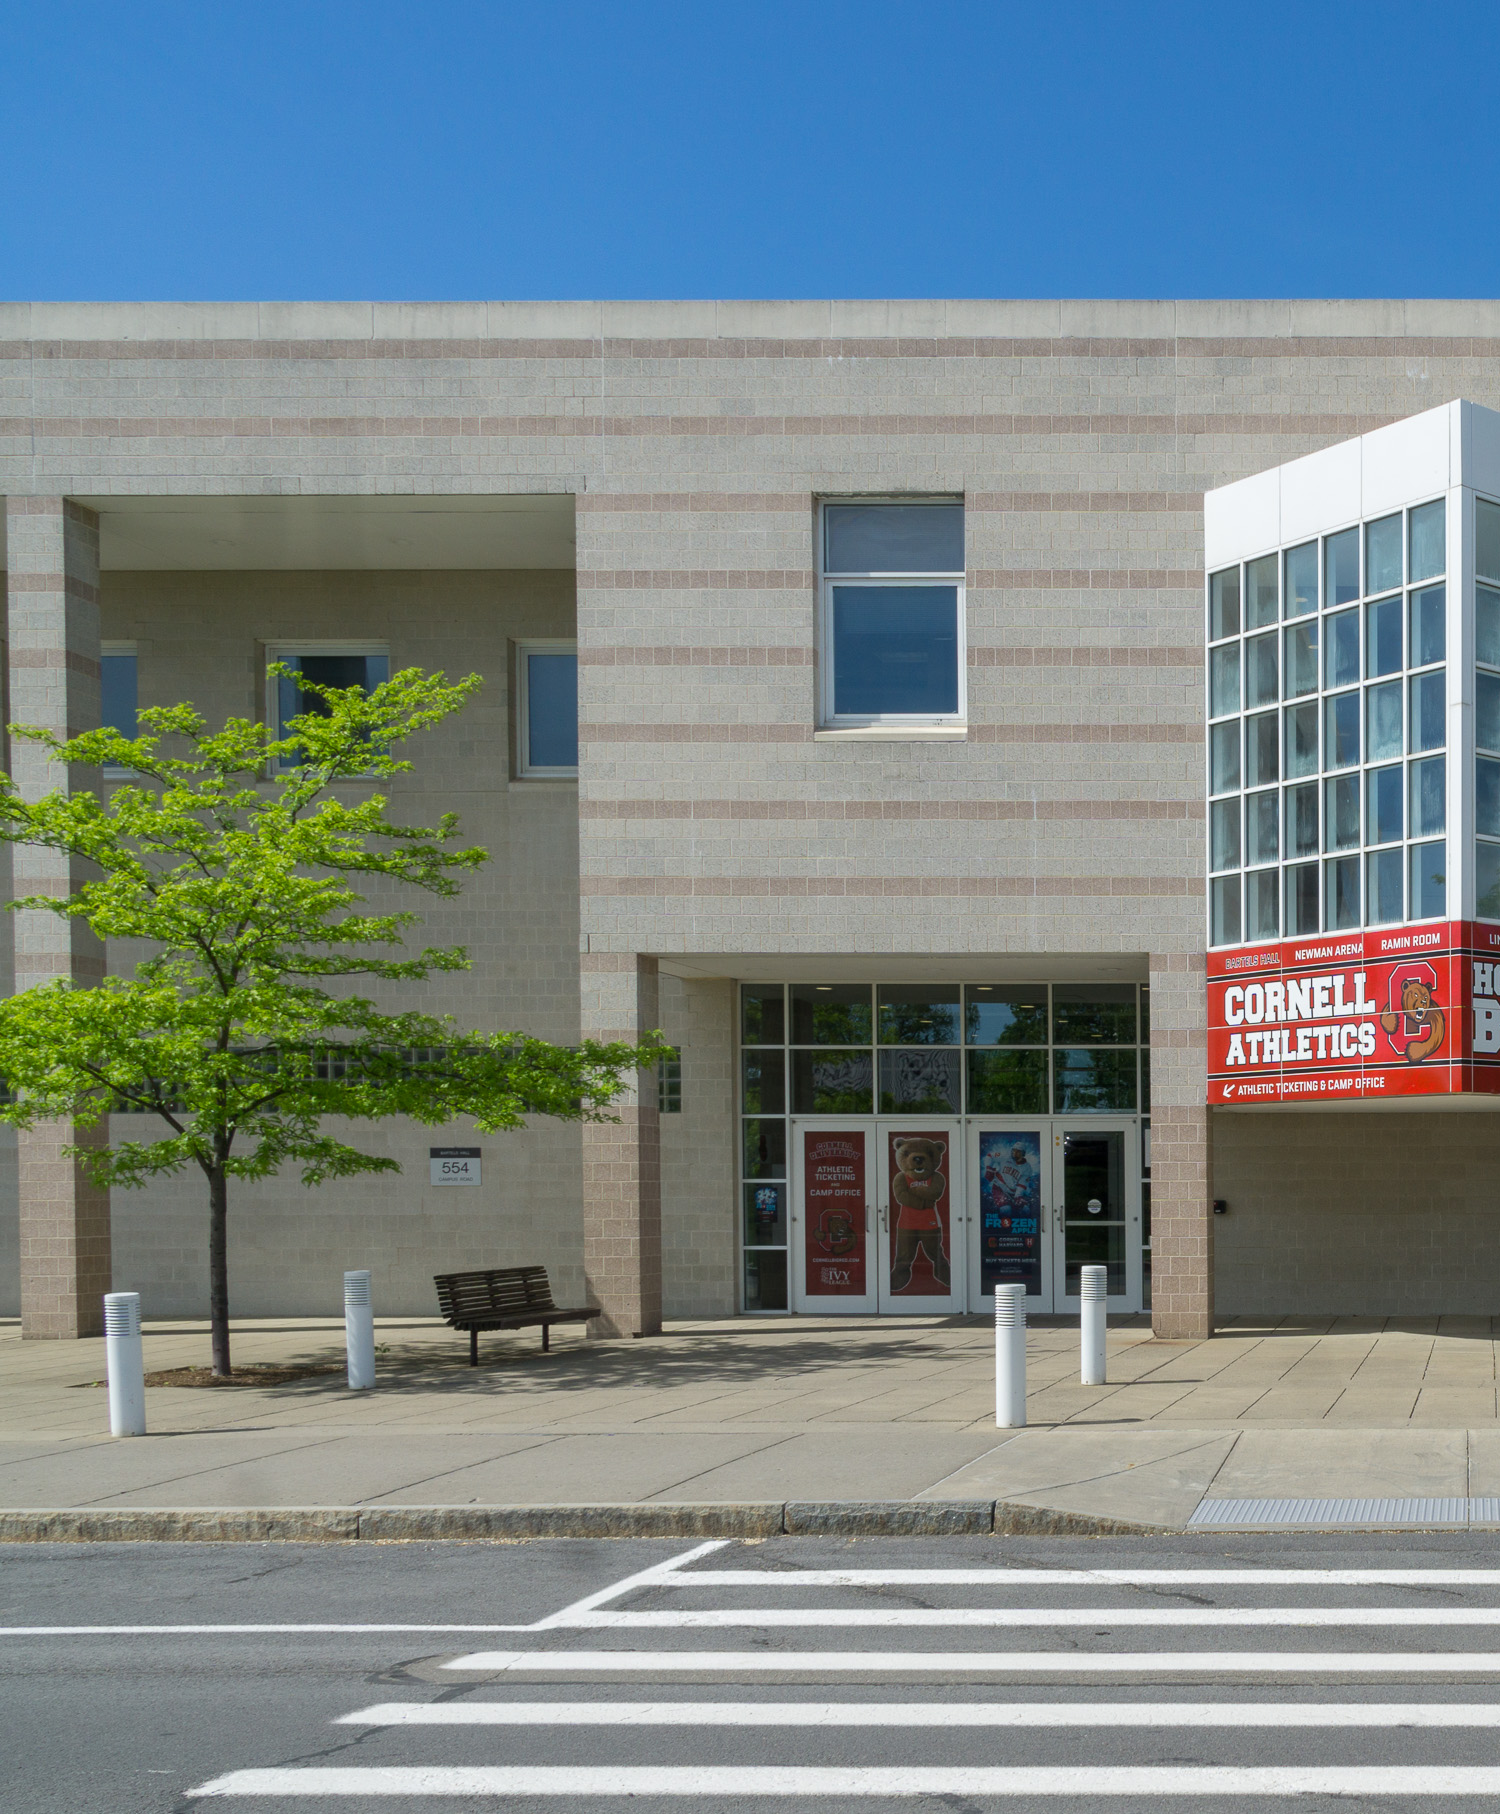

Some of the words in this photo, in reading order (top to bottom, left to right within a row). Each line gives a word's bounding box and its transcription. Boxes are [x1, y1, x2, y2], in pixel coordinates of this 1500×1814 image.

[1381, 936, 1411, 951] RAMIN
[1412, 933, 1441, 947] ROOM
[1225, 955, 1259, 970] BARTELS
[1260, 952, 1280, 966] HALL
[1295, 946, 1333, 961] NEWMAN
[1335, 943, 1364, 955] ARENA
[1224, 972, 1376, 1026] CORNELL
[1225, 1022, 1376, 1066] ATHLETICS
[1238, 1082, 1275, 1096] ATHLETIC
[1275, 1080, 1319, 1095] TICKETING
[1320, 1080, 1326, 1091] &
[1328, 1078, 1353, 1091] CAMP
[1355, 1077, 1385, 1089] OFFICE
[442, 1162, 469, 1174] 554
[810, 1189, 833, 1197] CAMP
[834, 1189, 861, 1197] OFFICE
[829, 1271, 850, 1280] IVY
